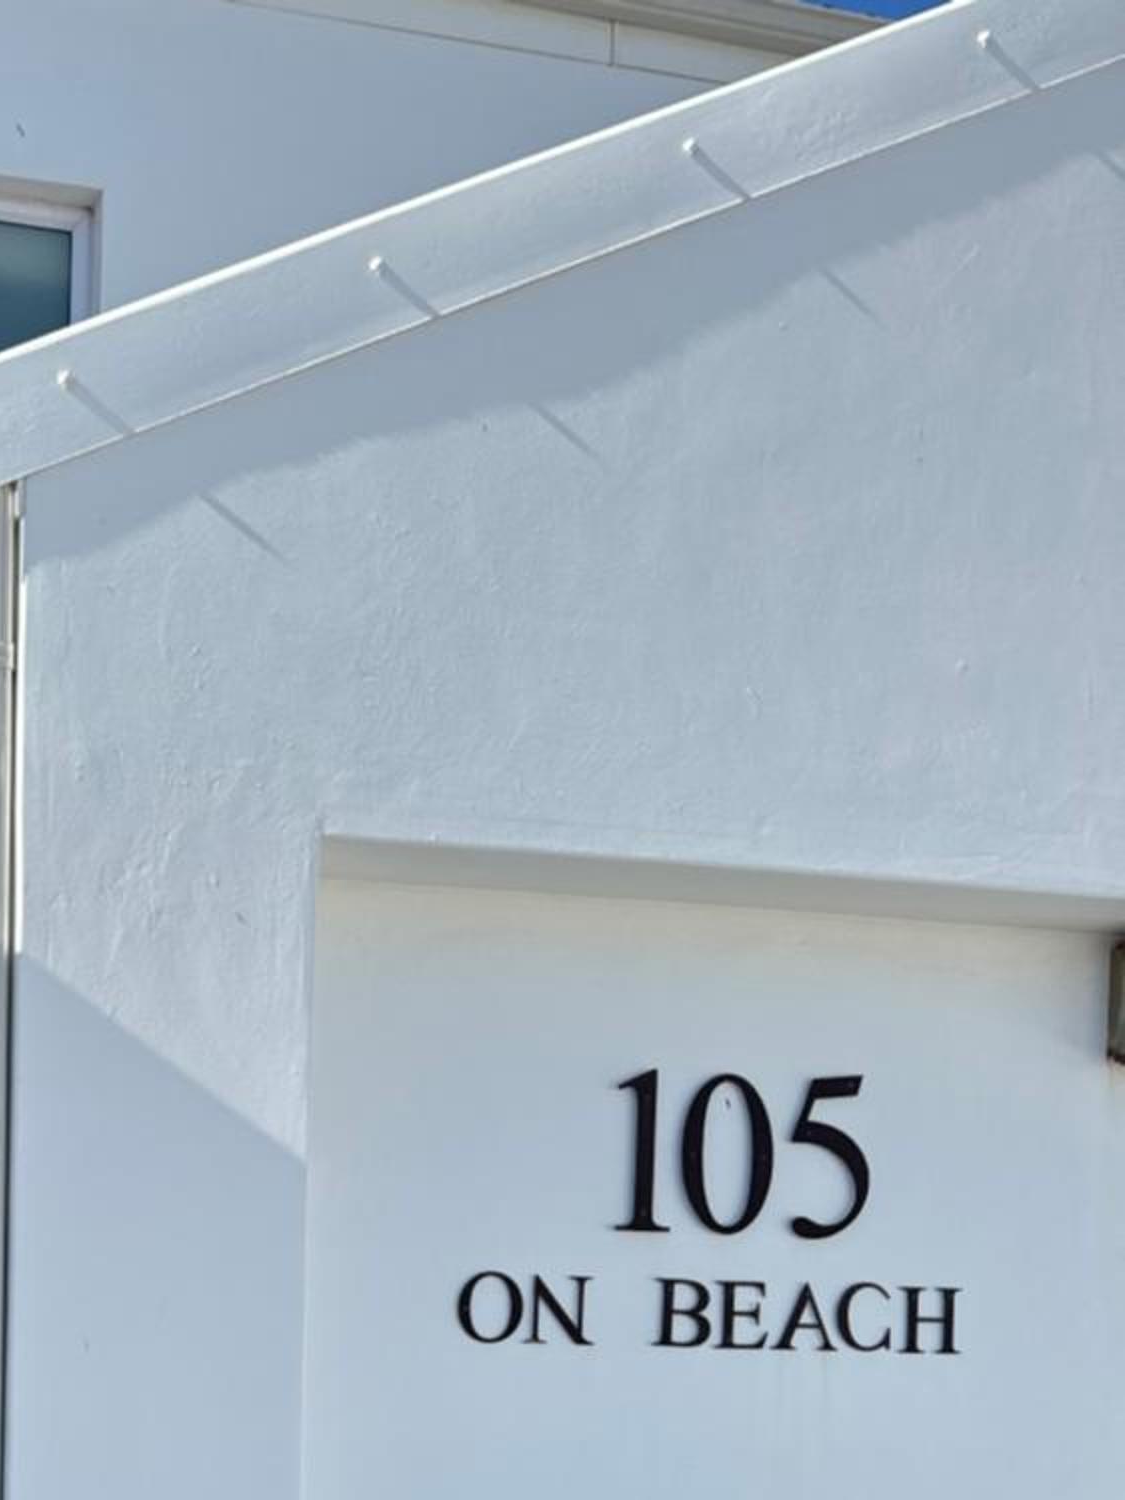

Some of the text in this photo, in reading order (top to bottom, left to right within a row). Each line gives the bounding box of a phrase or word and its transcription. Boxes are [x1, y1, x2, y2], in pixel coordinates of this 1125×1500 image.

[612, 1068, 870, 1239] 105
[457, 1271, 963, 1355] ON BEACH
